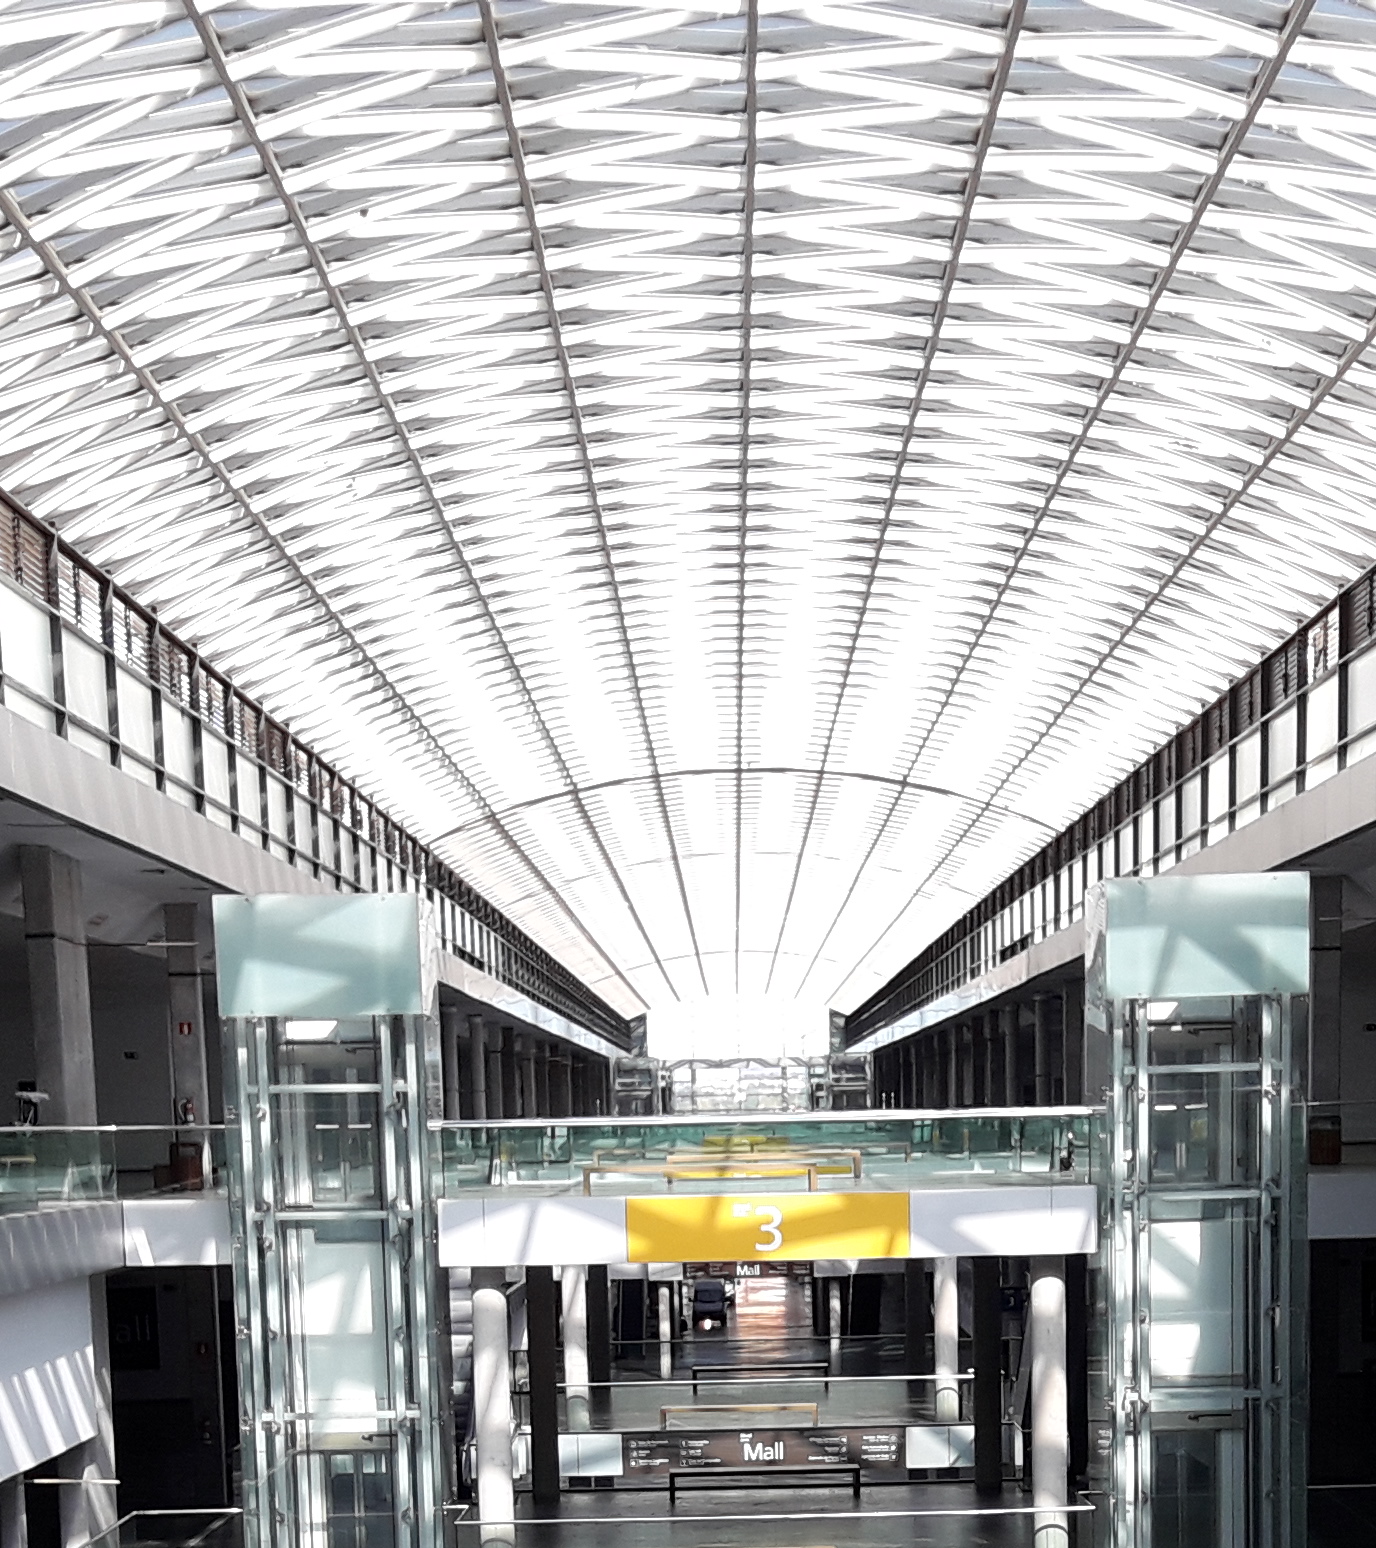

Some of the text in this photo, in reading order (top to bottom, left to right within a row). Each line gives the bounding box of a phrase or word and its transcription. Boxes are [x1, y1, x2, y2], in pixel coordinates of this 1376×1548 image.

[754, 1205, 783, 1252] 3
[736, 1264, 760, 1276] Mall
[743, 1441, 784, 1461] Mall
